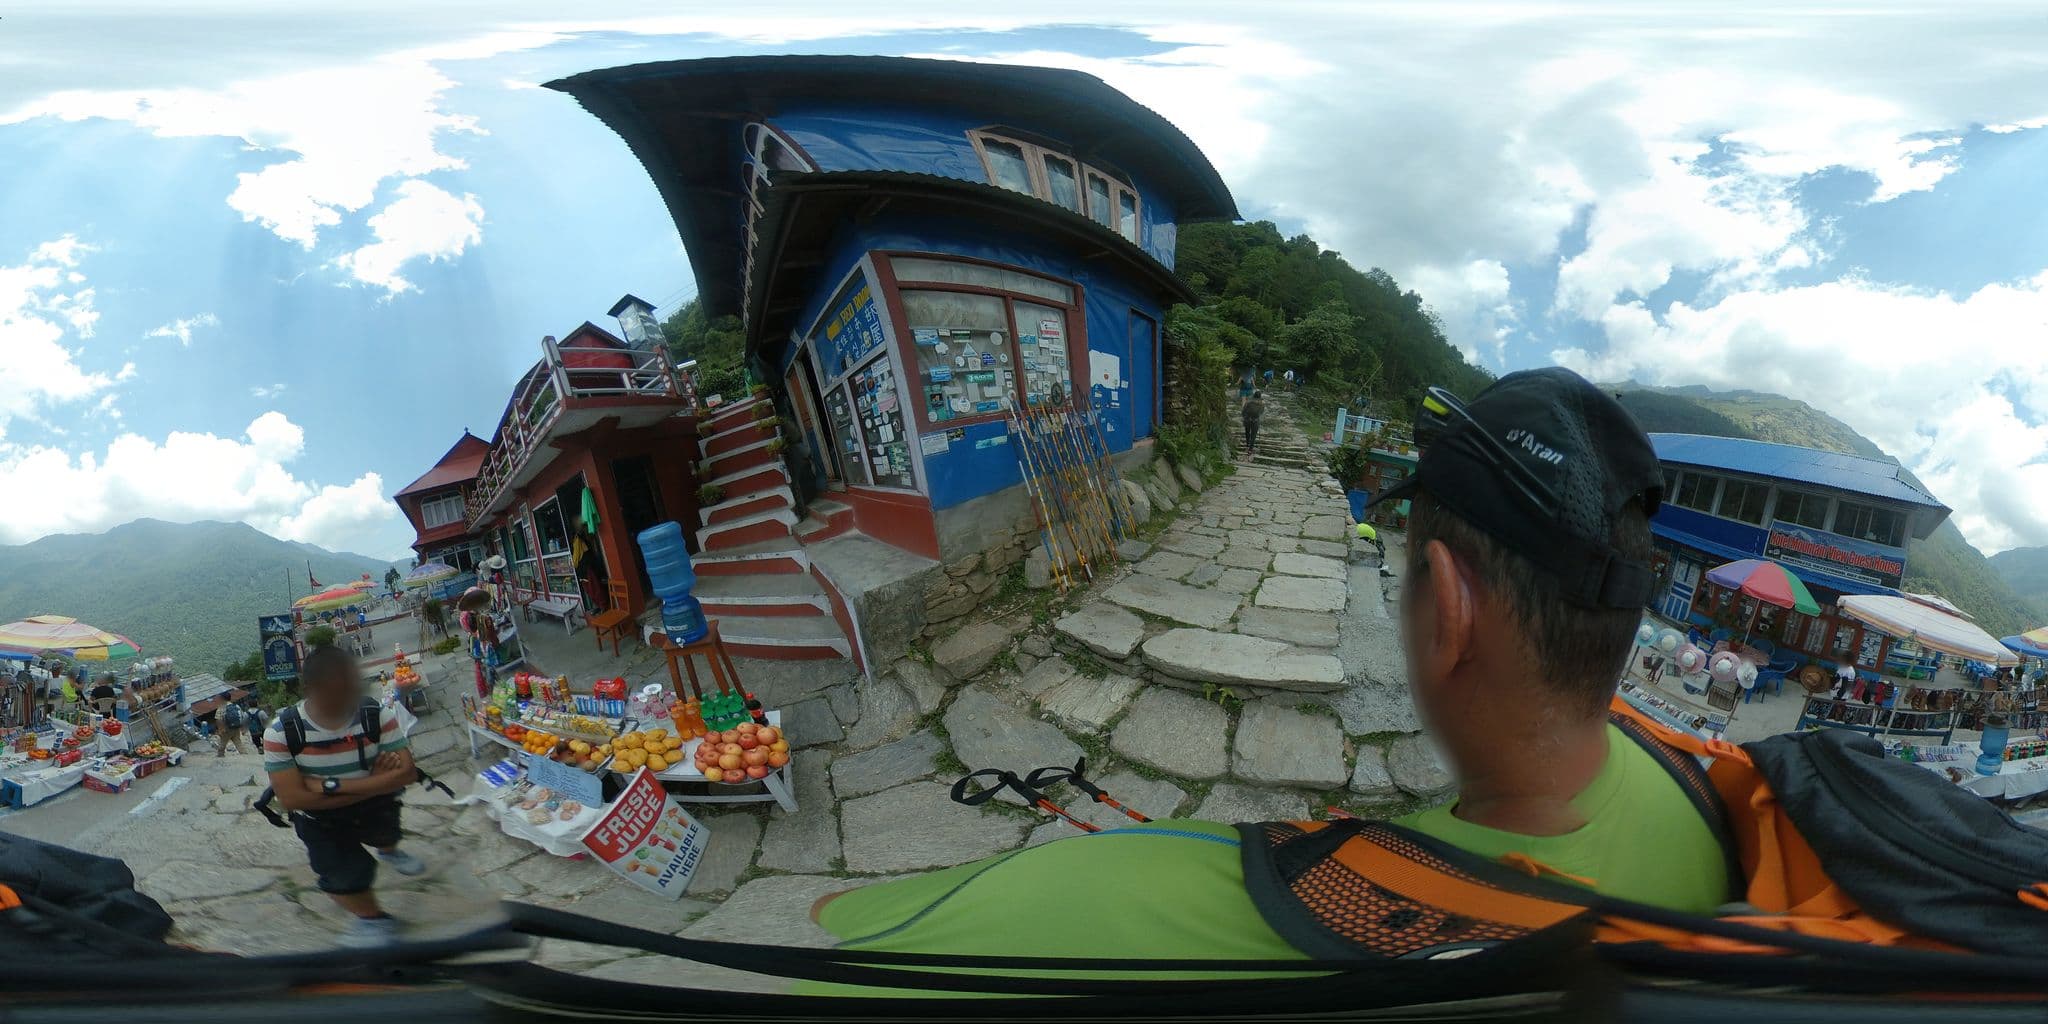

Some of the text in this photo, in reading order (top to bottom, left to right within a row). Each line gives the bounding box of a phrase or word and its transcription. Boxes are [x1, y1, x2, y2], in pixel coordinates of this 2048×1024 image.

[1790, 537, 1826, 558] Mountain
[1826, 544, 1848, 564] View
[1848, 550, 1873, 569] Guest
[1873, 556, 1901, 576] House
[595, 779, 653, 846] FRESH
[616, 794, 661, 854] JUICE
[657, 823, 699, 888] AVAILABLE
[679, 845, 701, 877] HERE
